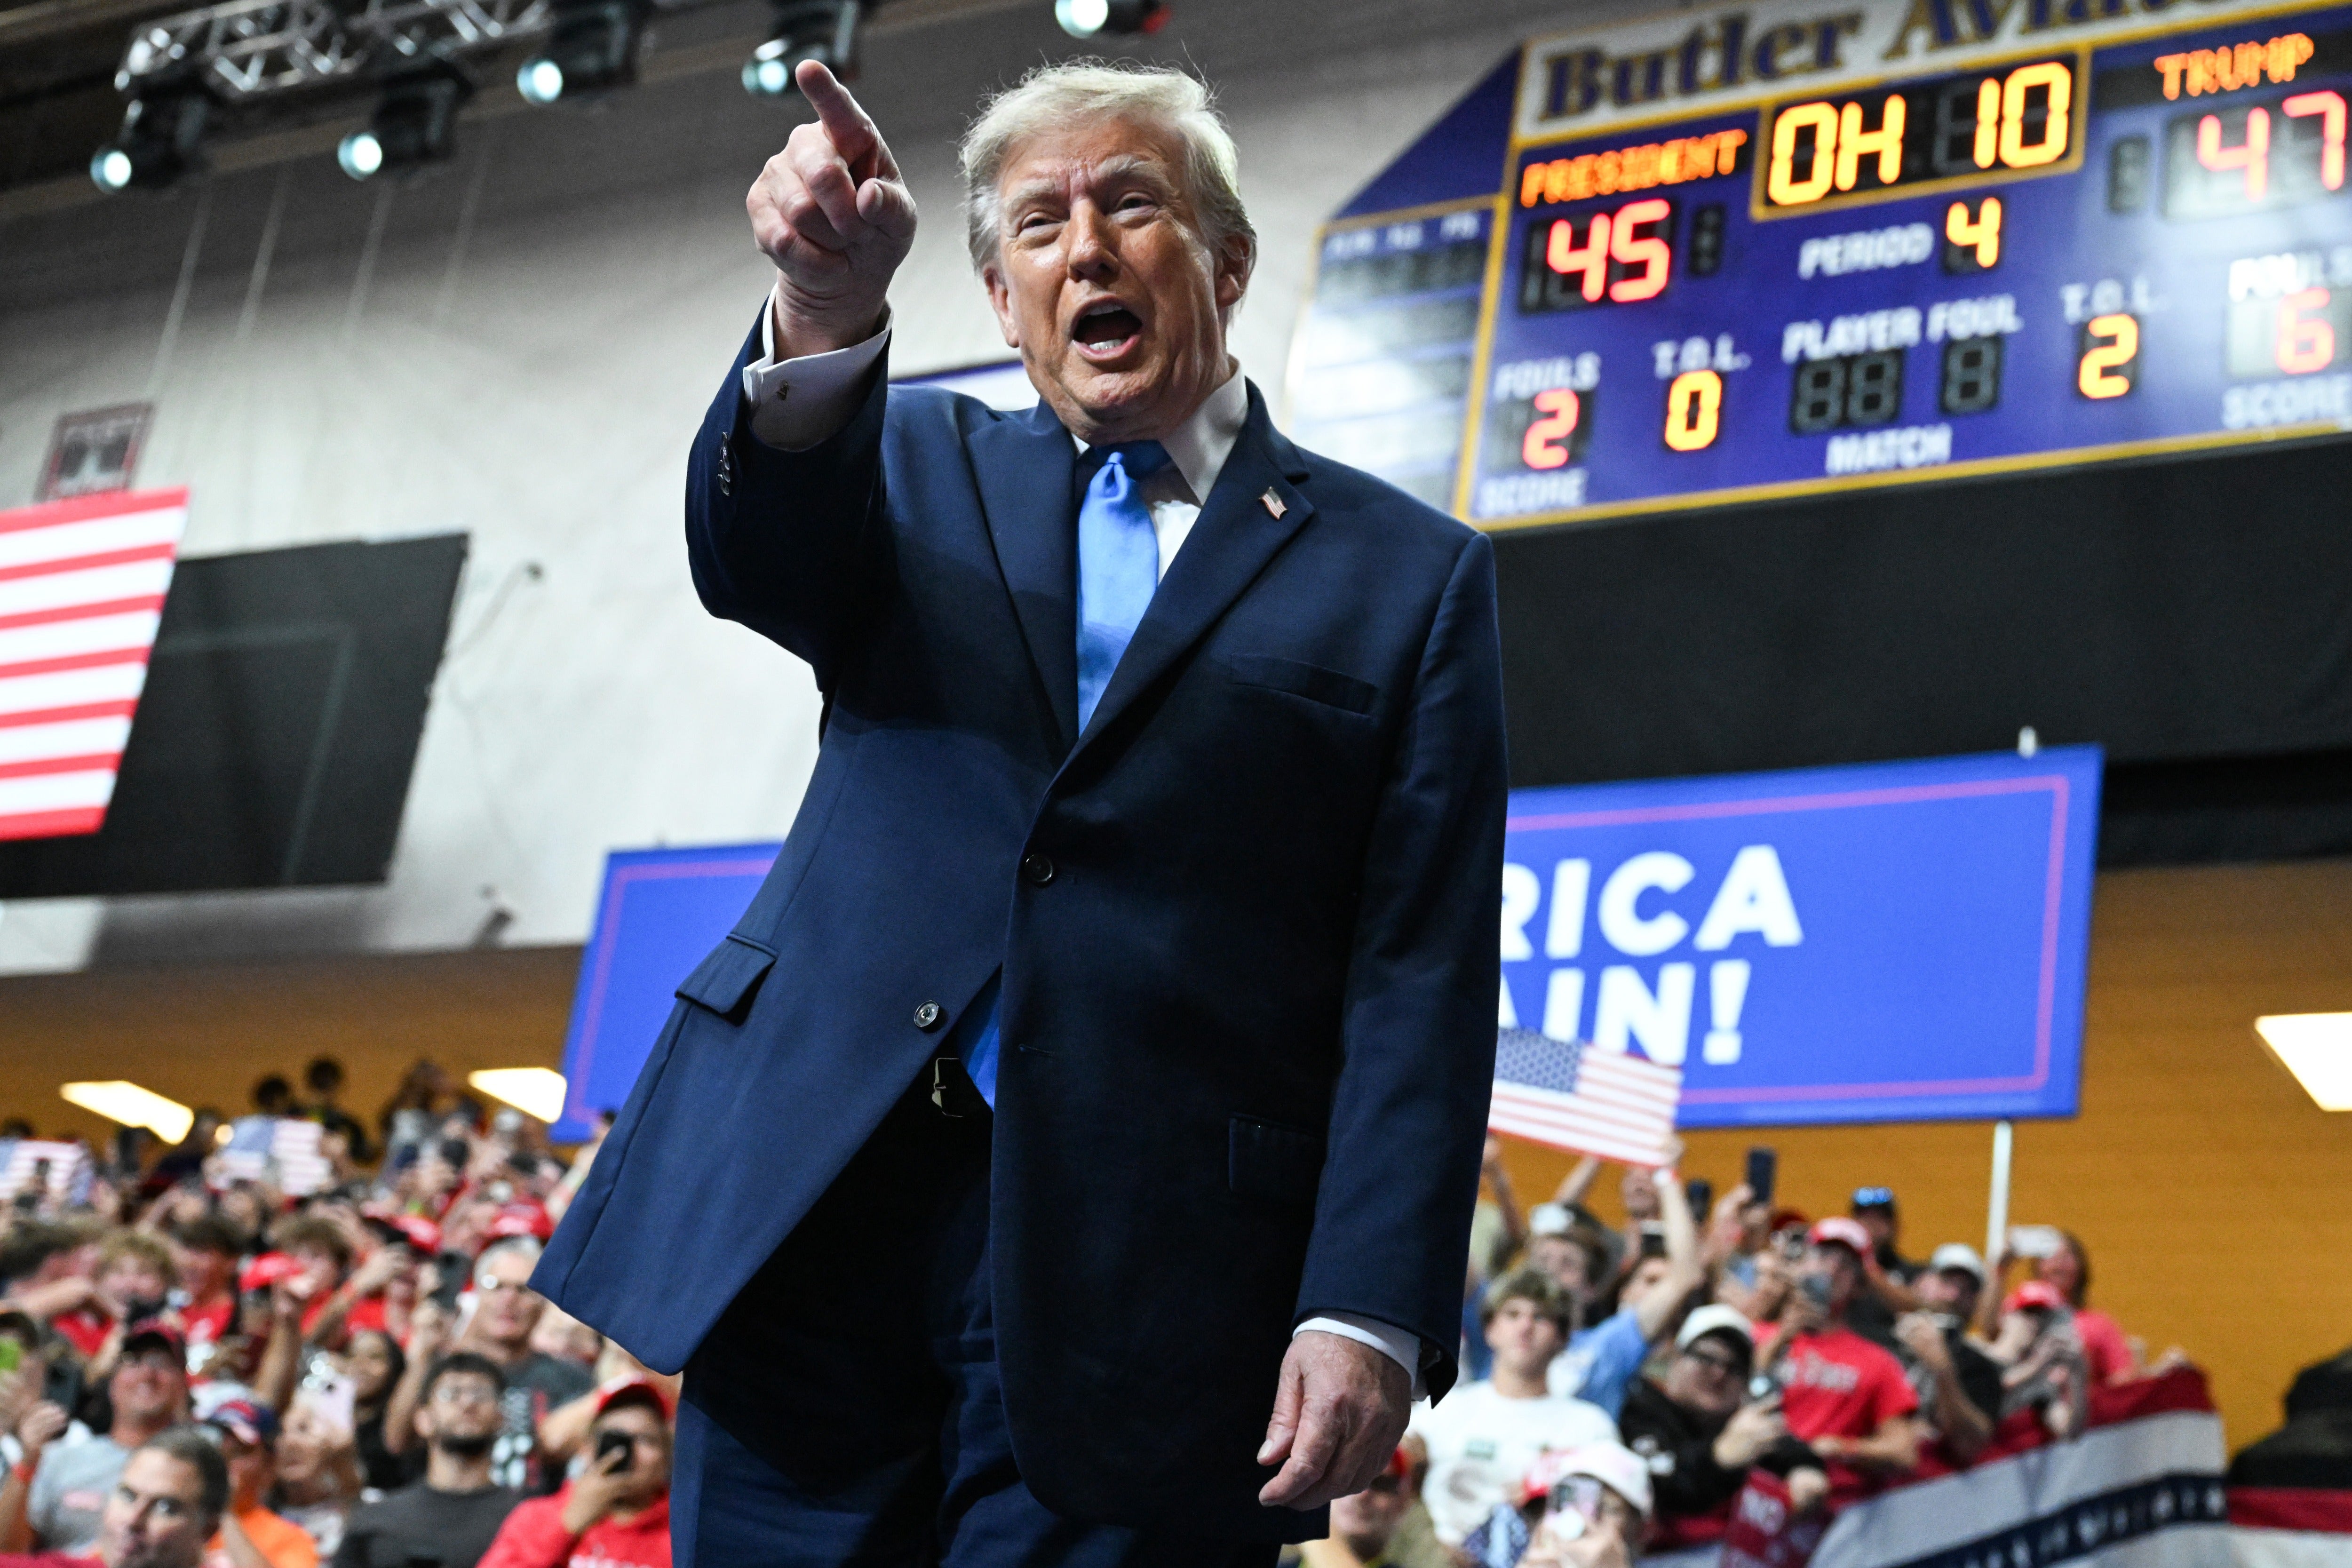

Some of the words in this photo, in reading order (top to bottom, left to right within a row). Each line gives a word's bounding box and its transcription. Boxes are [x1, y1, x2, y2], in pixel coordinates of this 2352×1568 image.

[1537, 9, 1866, 123] Butler
[2154, 32, 2314, 100] TRUMP
[1521, 129, 1748, 208] PRESIDENT
[2197, 90, 2347, 201] 47
[1547, 199, 1671, 302] 45
[1798, 221, 1934, 279] PERIOD
[1946, 197, 2002, 268] 4
[1781, 305, 1923, 364] PLAYER
[1926, 293, 2022, 343] FOUL
[2079, 313, 2138, 399] 2
[2275, 287, 2335, 374] 6
[1494, 350, 1601, 401] FOULS
[1523, 388, 1580, 470] 2
[1825, 422, 1953, 476] MATCH
